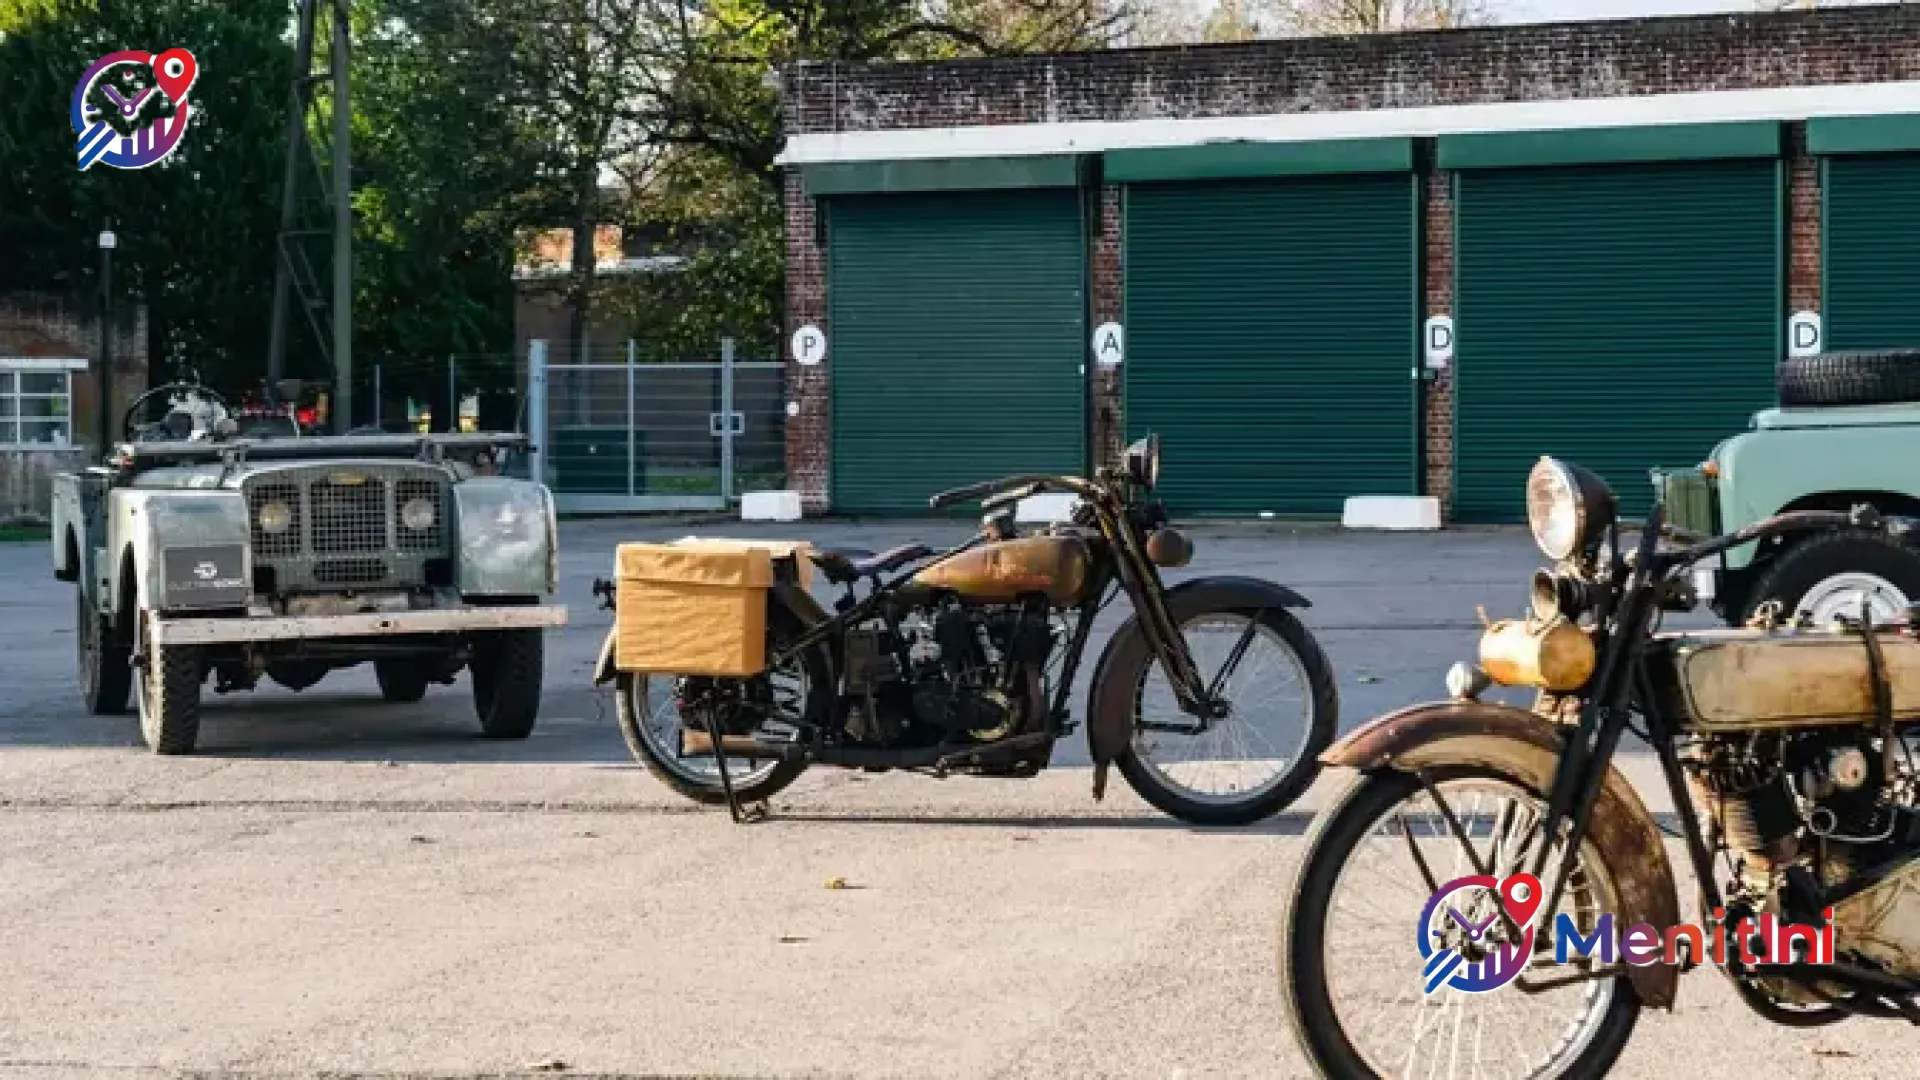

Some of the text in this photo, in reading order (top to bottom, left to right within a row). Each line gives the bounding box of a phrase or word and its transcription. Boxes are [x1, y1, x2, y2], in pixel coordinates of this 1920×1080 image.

[802, 335, 817, 357] P
[1101, 331, 1119, 354] A
[1431, 325, 1452, 350] D
[1794, 322, 1818, 348] D
